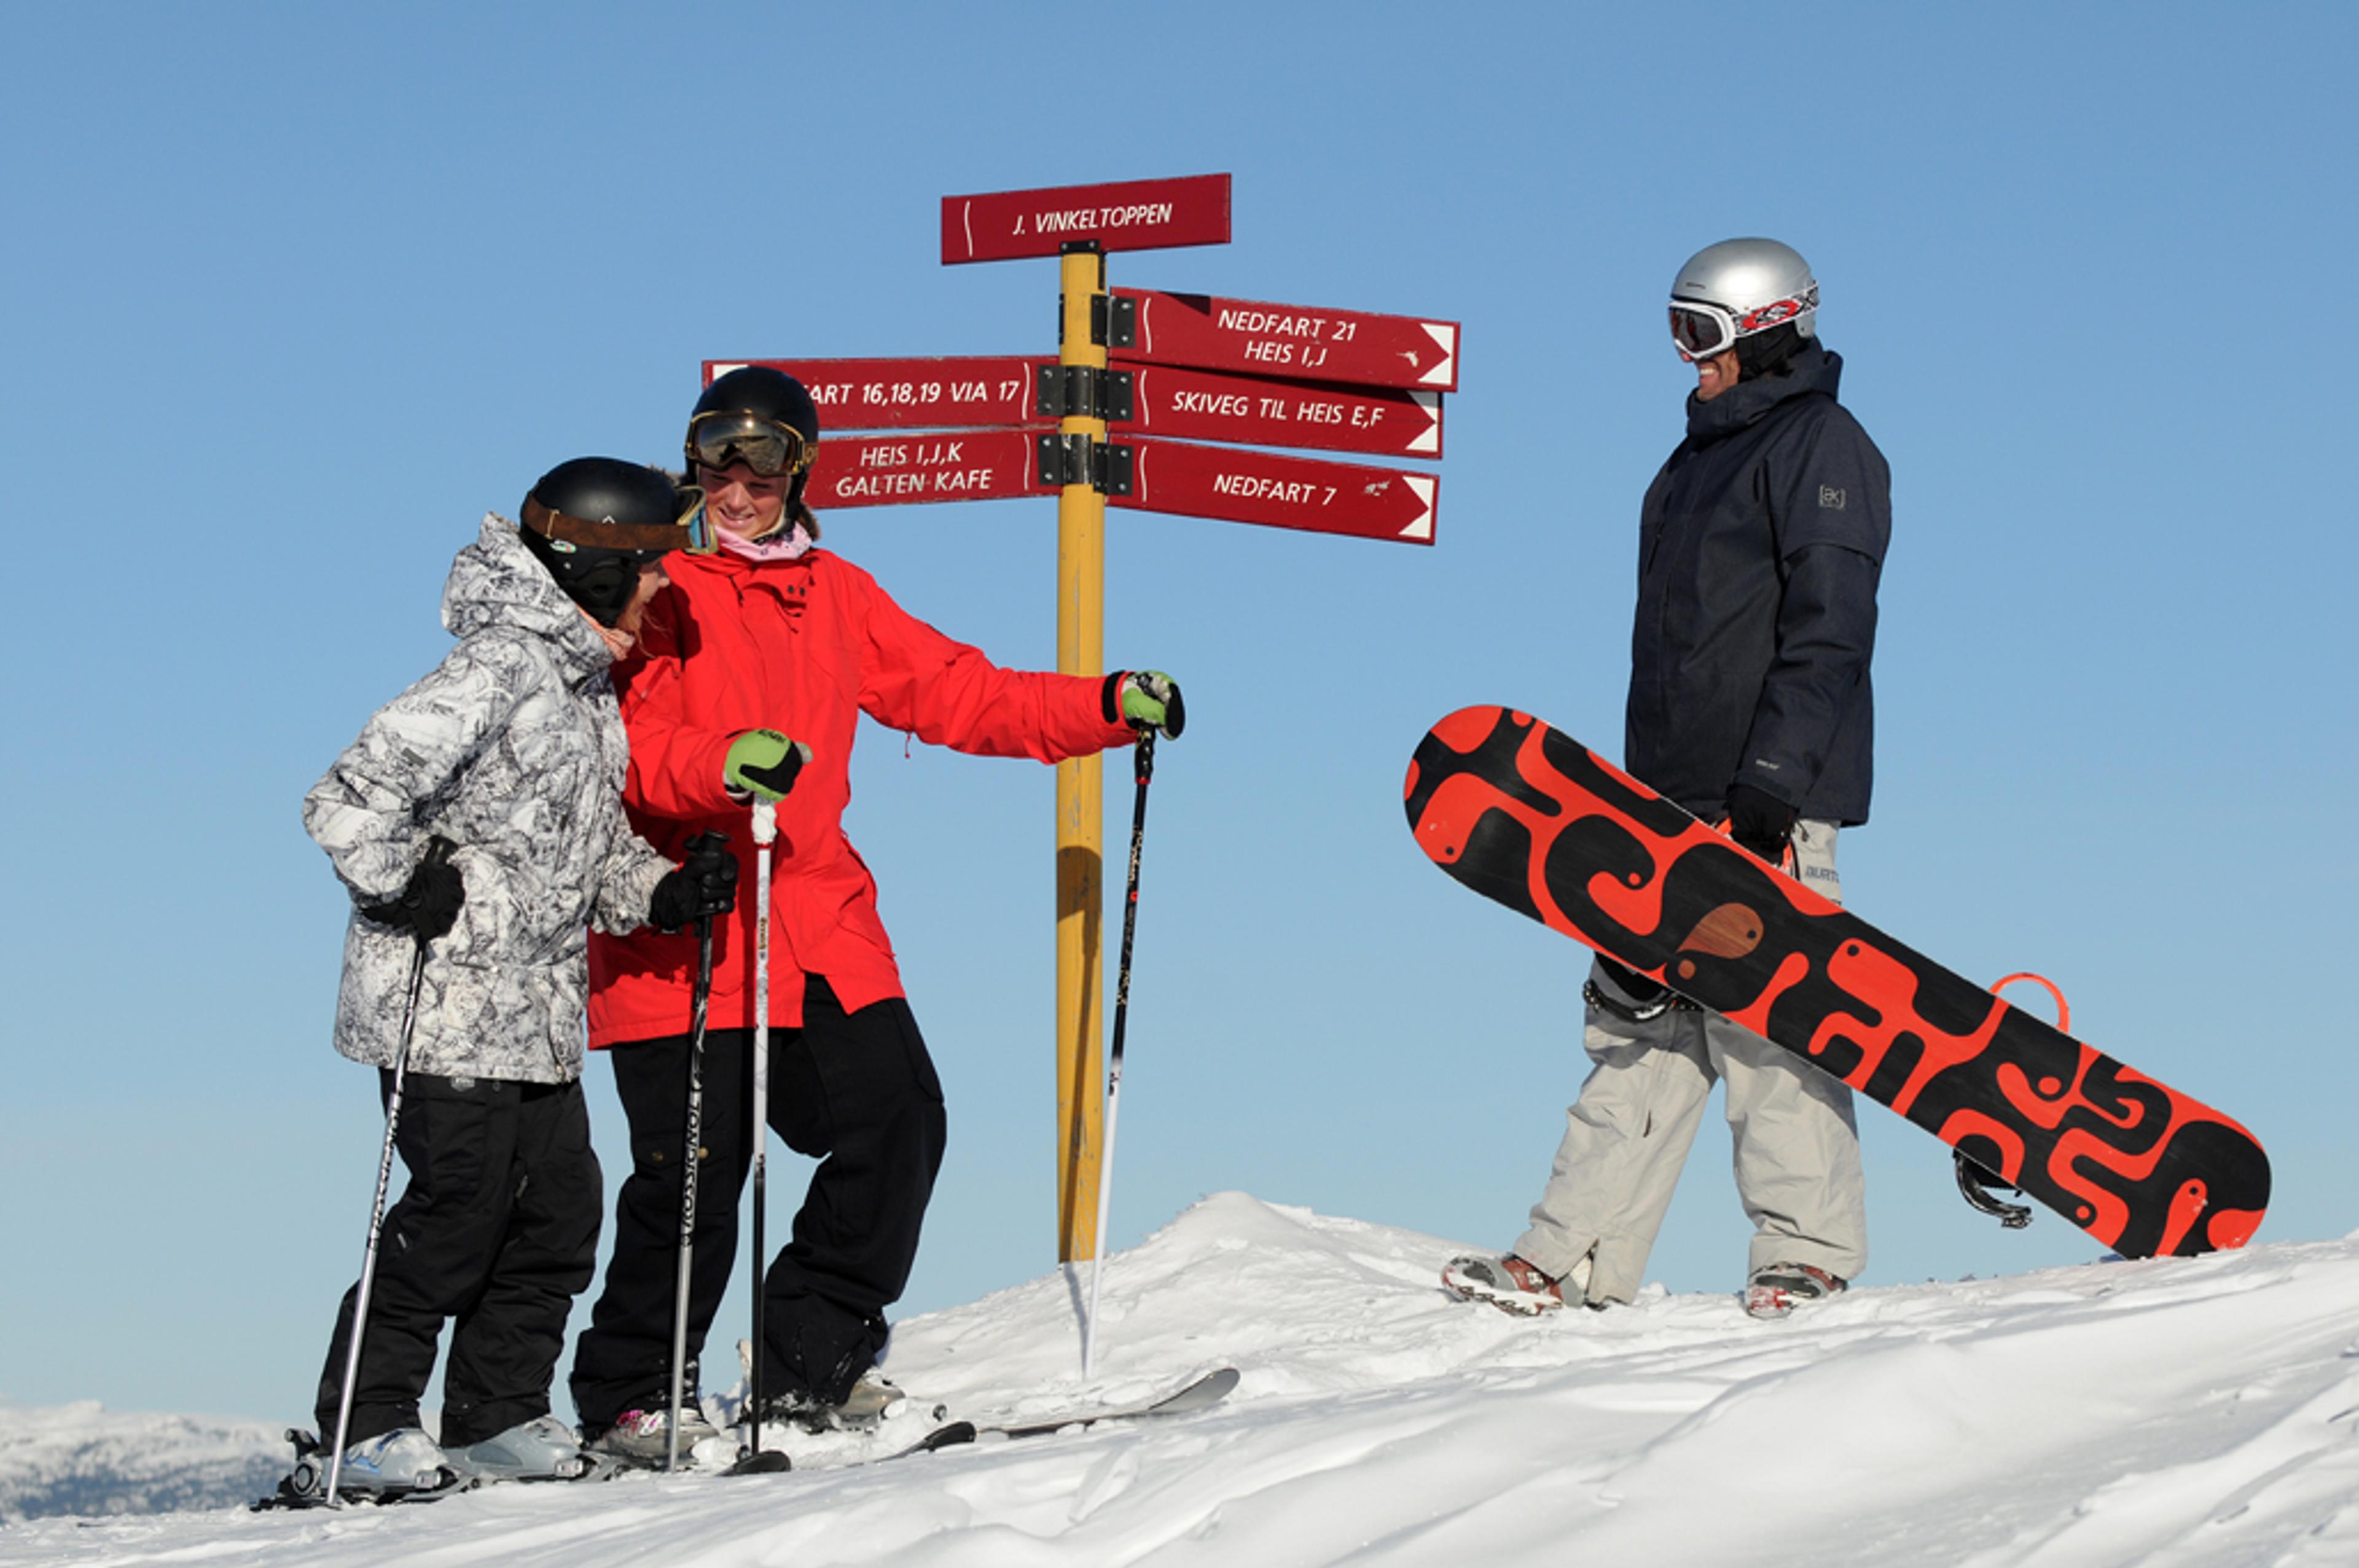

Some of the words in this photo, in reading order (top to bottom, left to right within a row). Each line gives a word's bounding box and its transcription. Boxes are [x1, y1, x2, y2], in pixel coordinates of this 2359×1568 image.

[1012, 215, 1025, 235] J.
[1035, 203, 1173, 233] VINKELTOPPEN
[1218, 310, 1326, 338] NEDFART
[1331, 322, 1356, 341] 21
[1244, 340, 1294, 364] HEIS
[1301, 346, 1328, 367] I,J
[804, 383, 855, 404] ART
[863, 382, 941, 407] 16,18,19
[950, 381, 987, 402] VIA
[998, 380, 1020, 402] 17
[1172, 391, 1248, 416] SKIVEG
[1259, 398, 1287, 420] TIL
[1297, 402, 1344, 424] HEIS
[1351, 405, 1385, 429] E,F
[860, 445, 907, 467] HEIS
[916, 442, 964, 466] I,J,K
[836, 472, 925, 497] GALTEN
[934, 469, 993, 491] KAFE
[1213, 474, 1316, 505] NEDFART
[1323, 486, 1337, 505] 7
[681, 1102, 700, 1228] ROSSIGNOL
